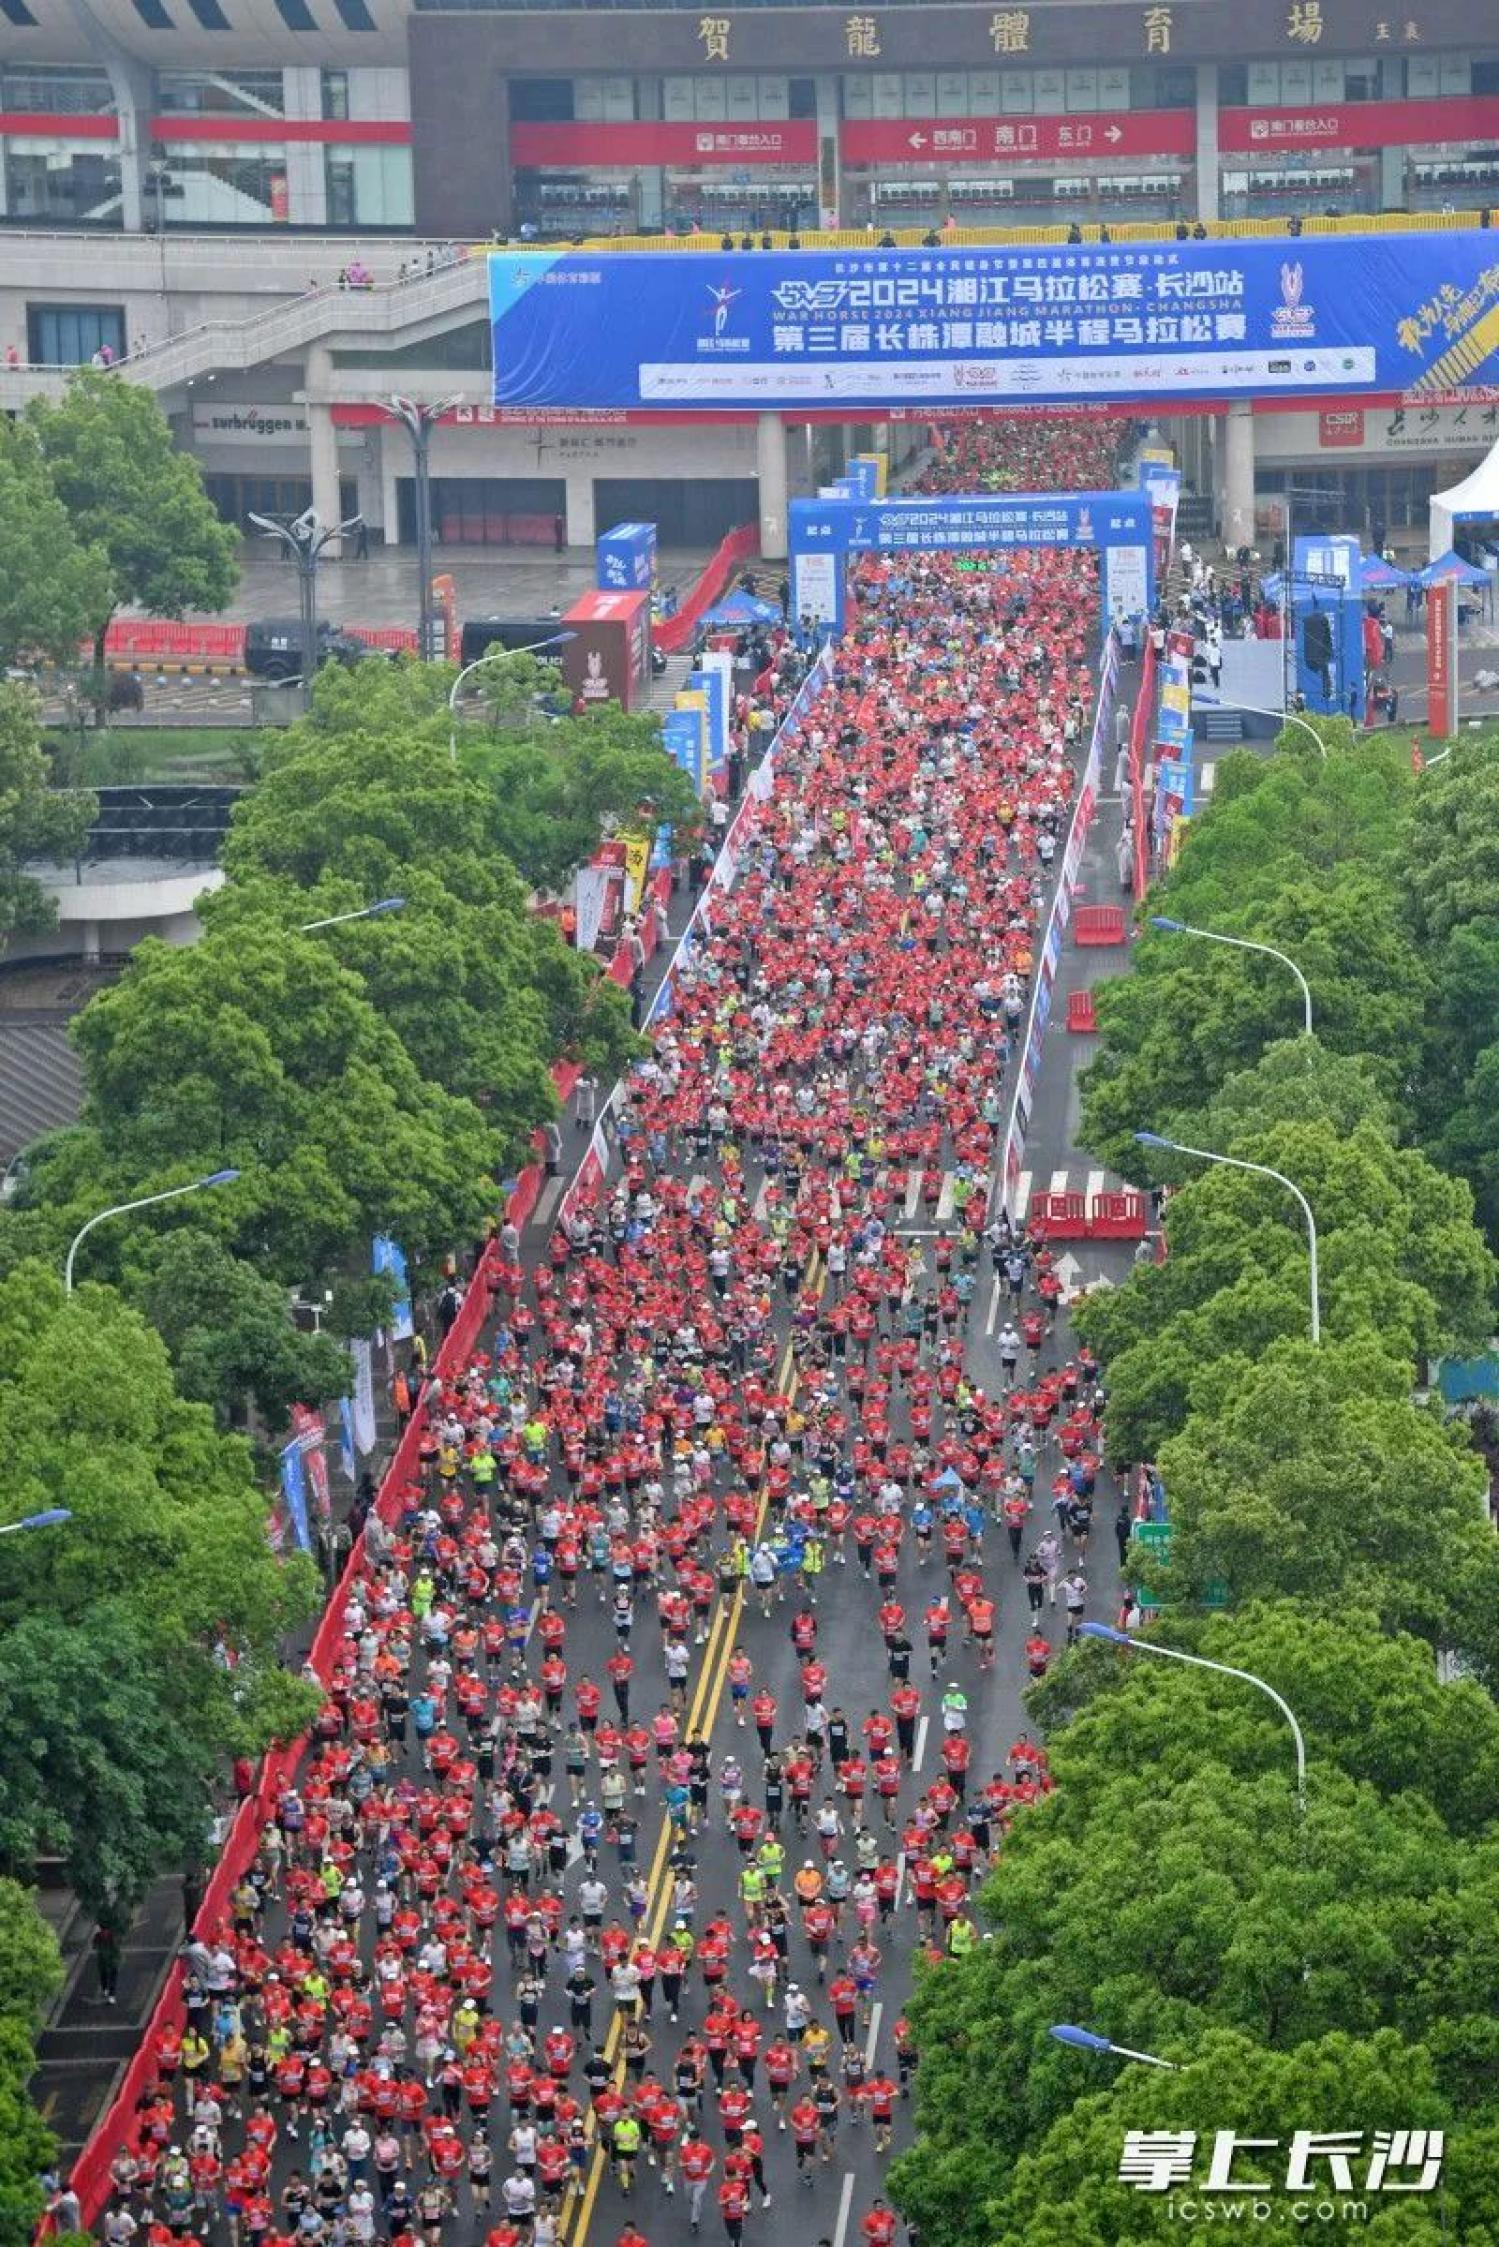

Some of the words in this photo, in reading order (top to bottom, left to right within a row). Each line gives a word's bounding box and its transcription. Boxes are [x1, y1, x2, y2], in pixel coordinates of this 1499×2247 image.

[932, 129, 977, 145] 西南门
[996, 125, 1037, 145] 南门
[1058, 125, 1092, 142] 东门
[773, 310, 808, 321] WAR
[814, 310, 869, 322] HORSE
[874, 309, 913, 320] 2024
[917, 307, 974, 319] XIANG
[977, 305, 1030, 318] JIANG
[1146, 298, 1242, 312] CHANGSHA
